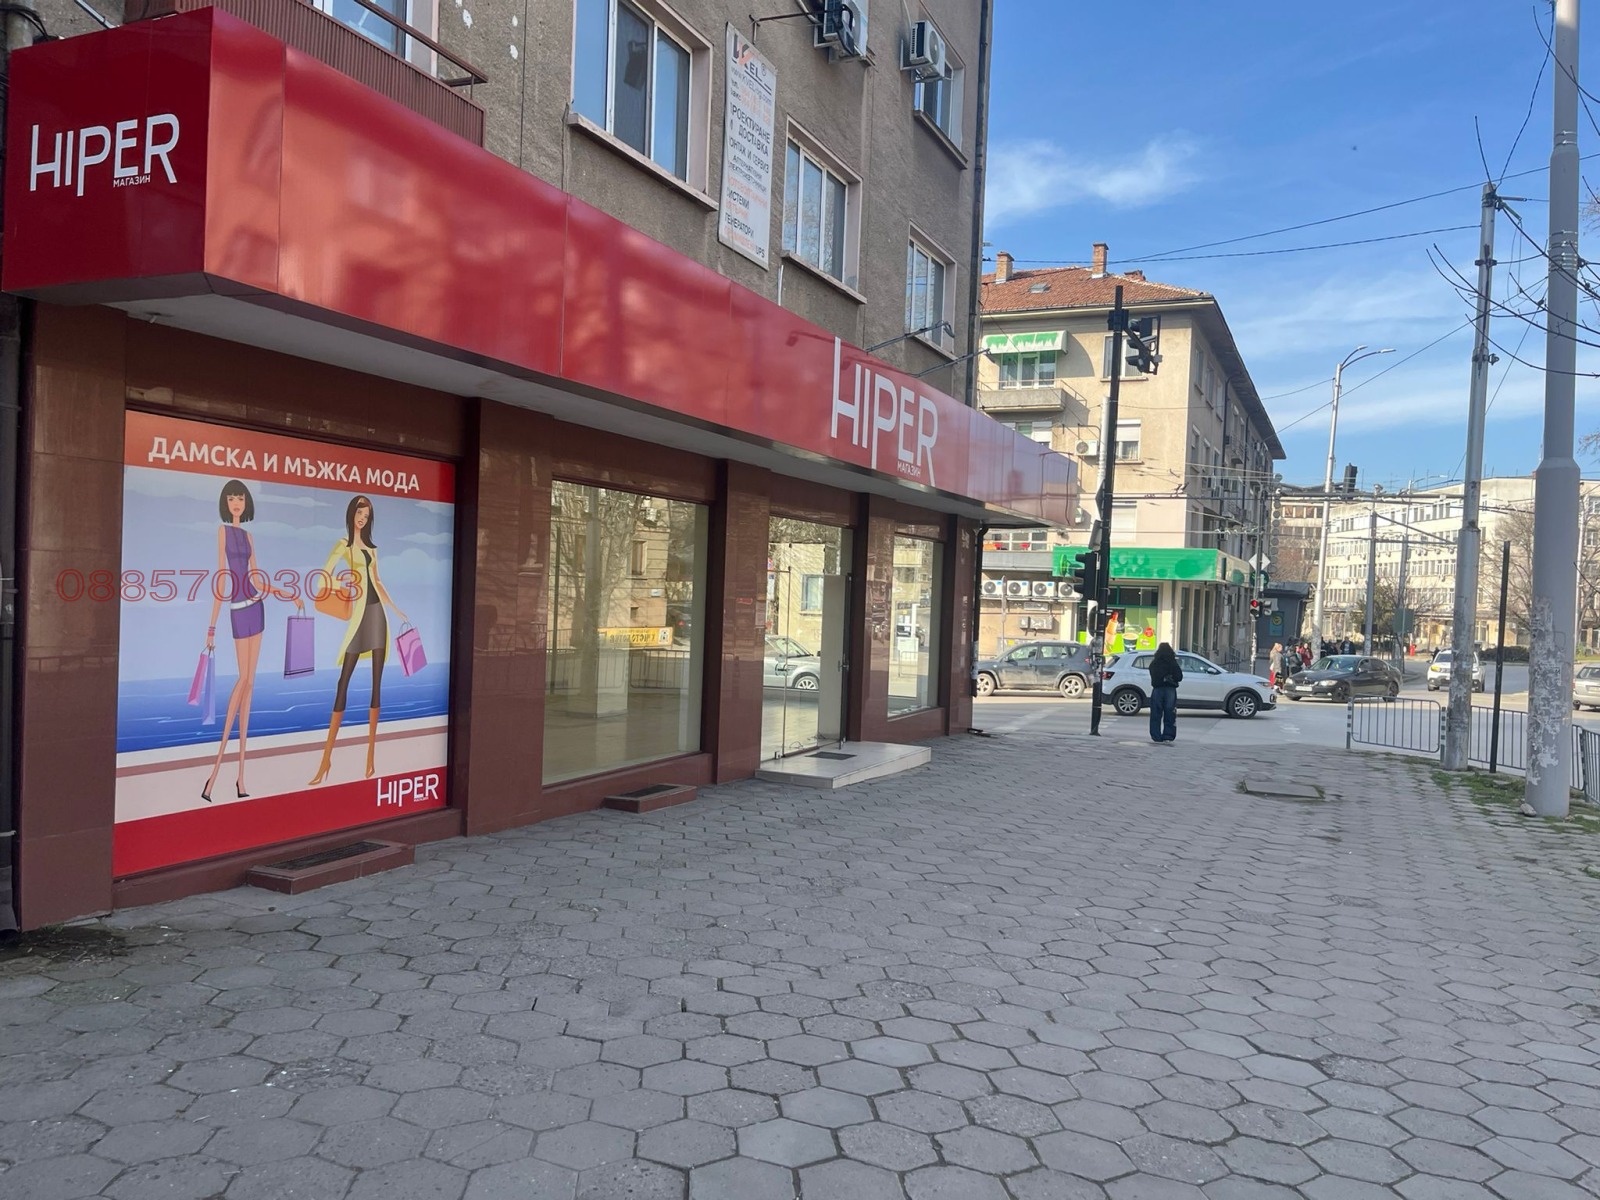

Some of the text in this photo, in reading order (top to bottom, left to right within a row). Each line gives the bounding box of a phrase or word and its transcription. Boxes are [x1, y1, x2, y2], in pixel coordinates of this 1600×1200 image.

[29, 113, 181, 197] HIPER
[112, 174, 152, 188] МАГАЗИН
[830, 336, 938, 487] HIPER
[148, 436, 420, 494] ДАМСКА И МЪЖКА МОДА
[897, 460, 922, 478] МАГАЗИН
[376, 773, 440, 808] HIPER
